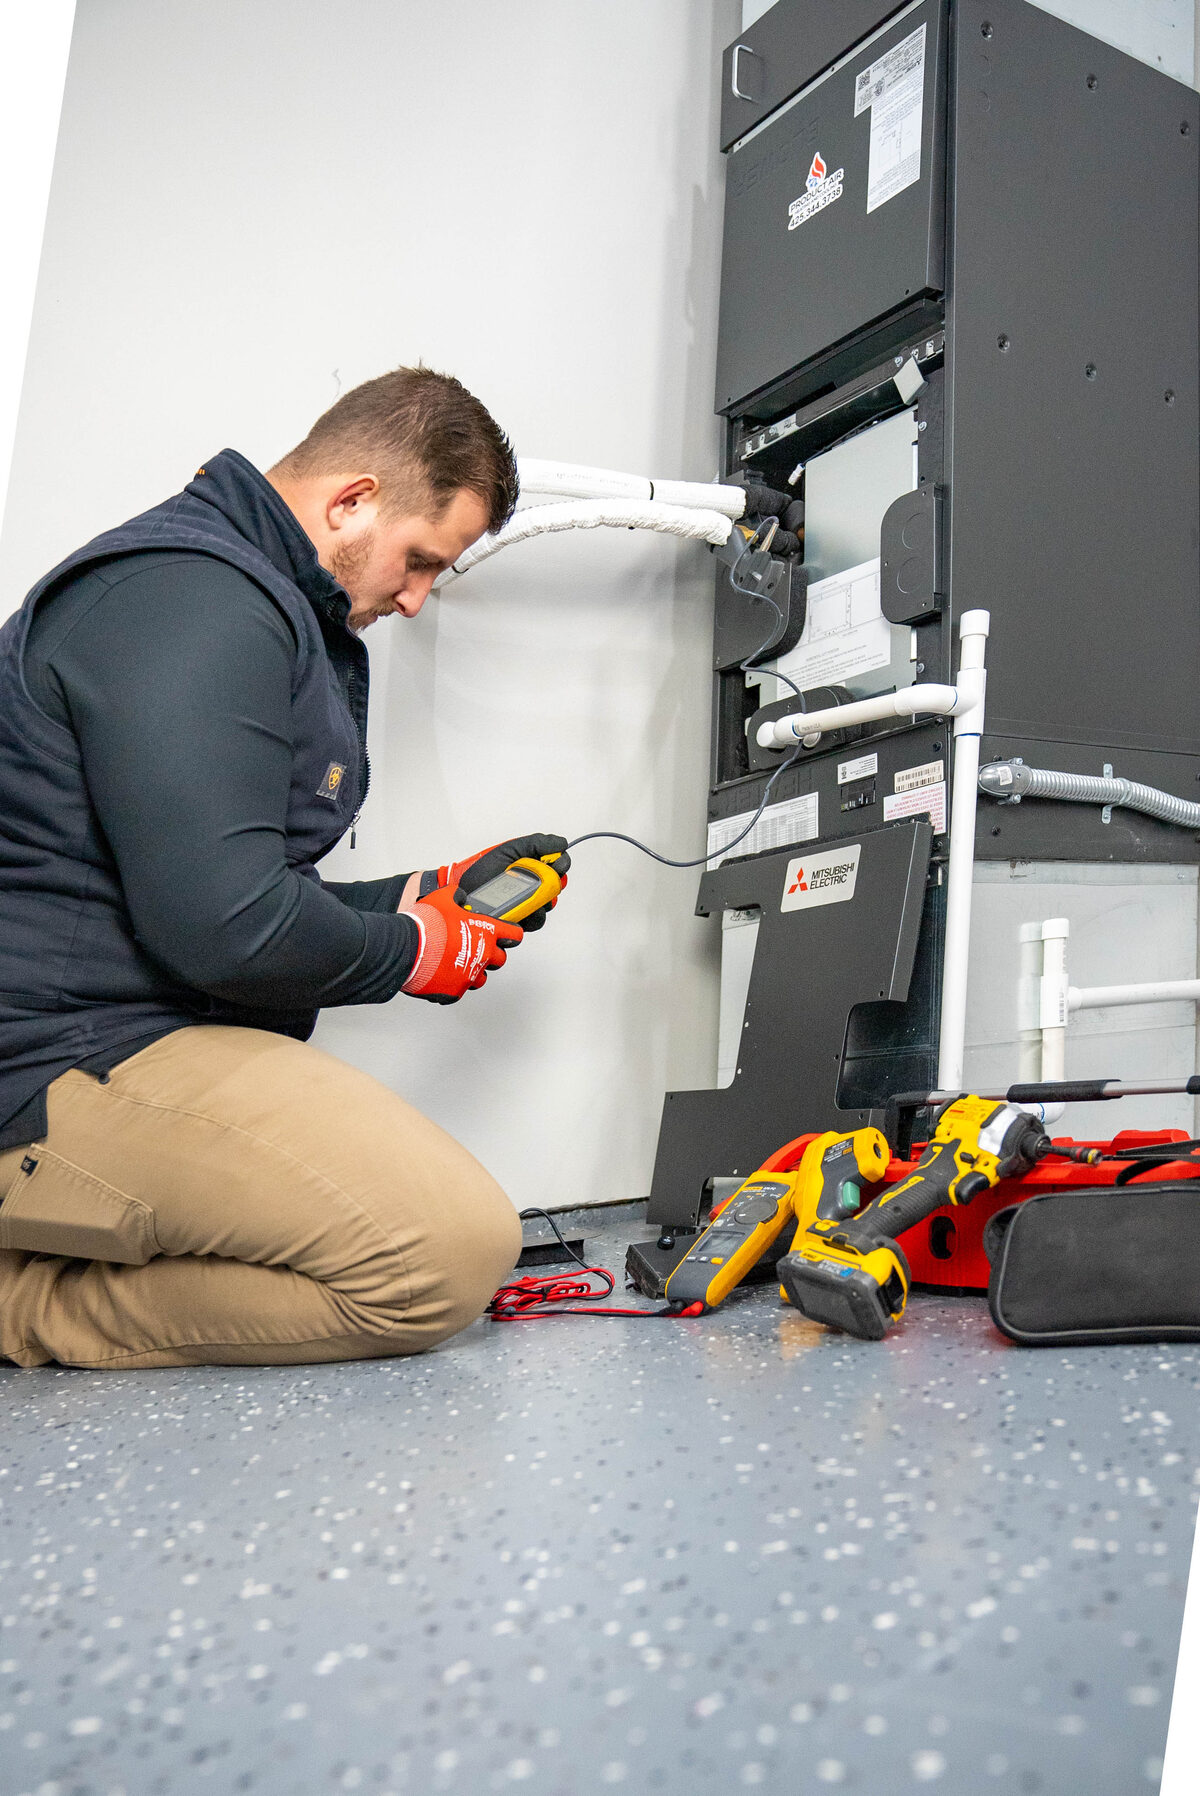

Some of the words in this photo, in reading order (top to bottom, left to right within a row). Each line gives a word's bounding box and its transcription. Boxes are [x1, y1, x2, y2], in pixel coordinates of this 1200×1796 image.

[789, 186, 841, 227] 425.344.3738
[790, 181, 828, 212] PRODUCT
[829, 171, 843, 184] AIR
[809, 874, 848, 890] ELECTRIC
[811, 862, 856, 880] MITSUBISHI
[454, 919, 468, 969] Milwaukee
